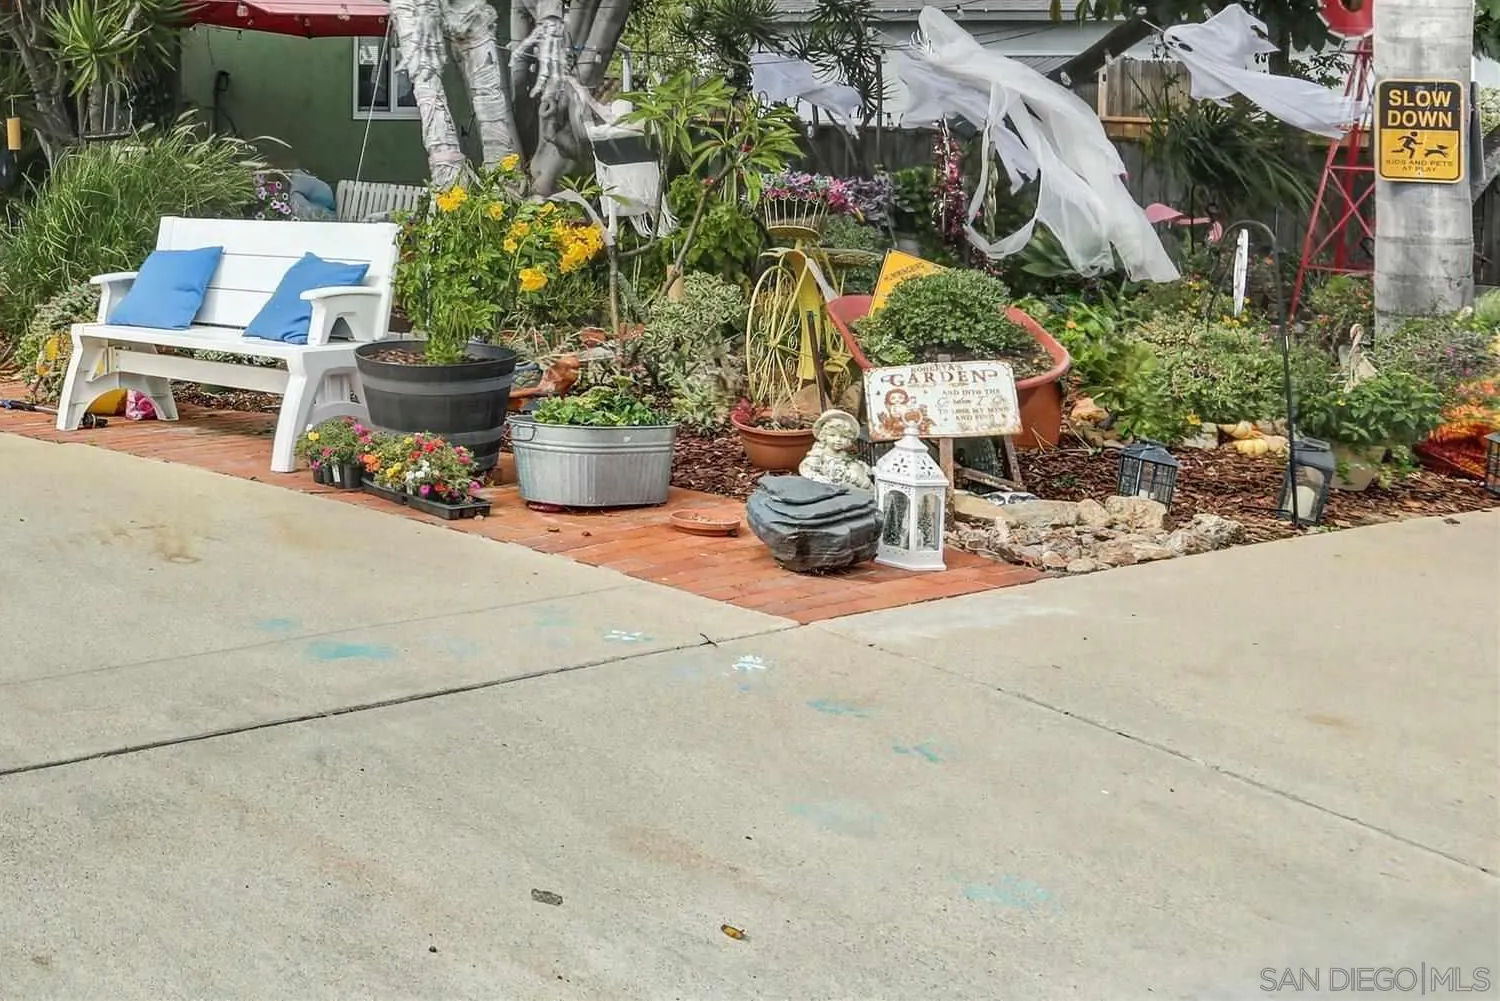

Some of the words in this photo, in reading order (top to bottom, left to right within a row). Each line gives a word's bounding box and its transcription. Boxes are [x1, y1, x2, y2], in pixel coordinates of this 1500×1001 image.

[1388, 89, 1452, 107] SLOW
[1387, 110, 1452, 128] DOWN
[881, 369, 998, 387] GARDEN
